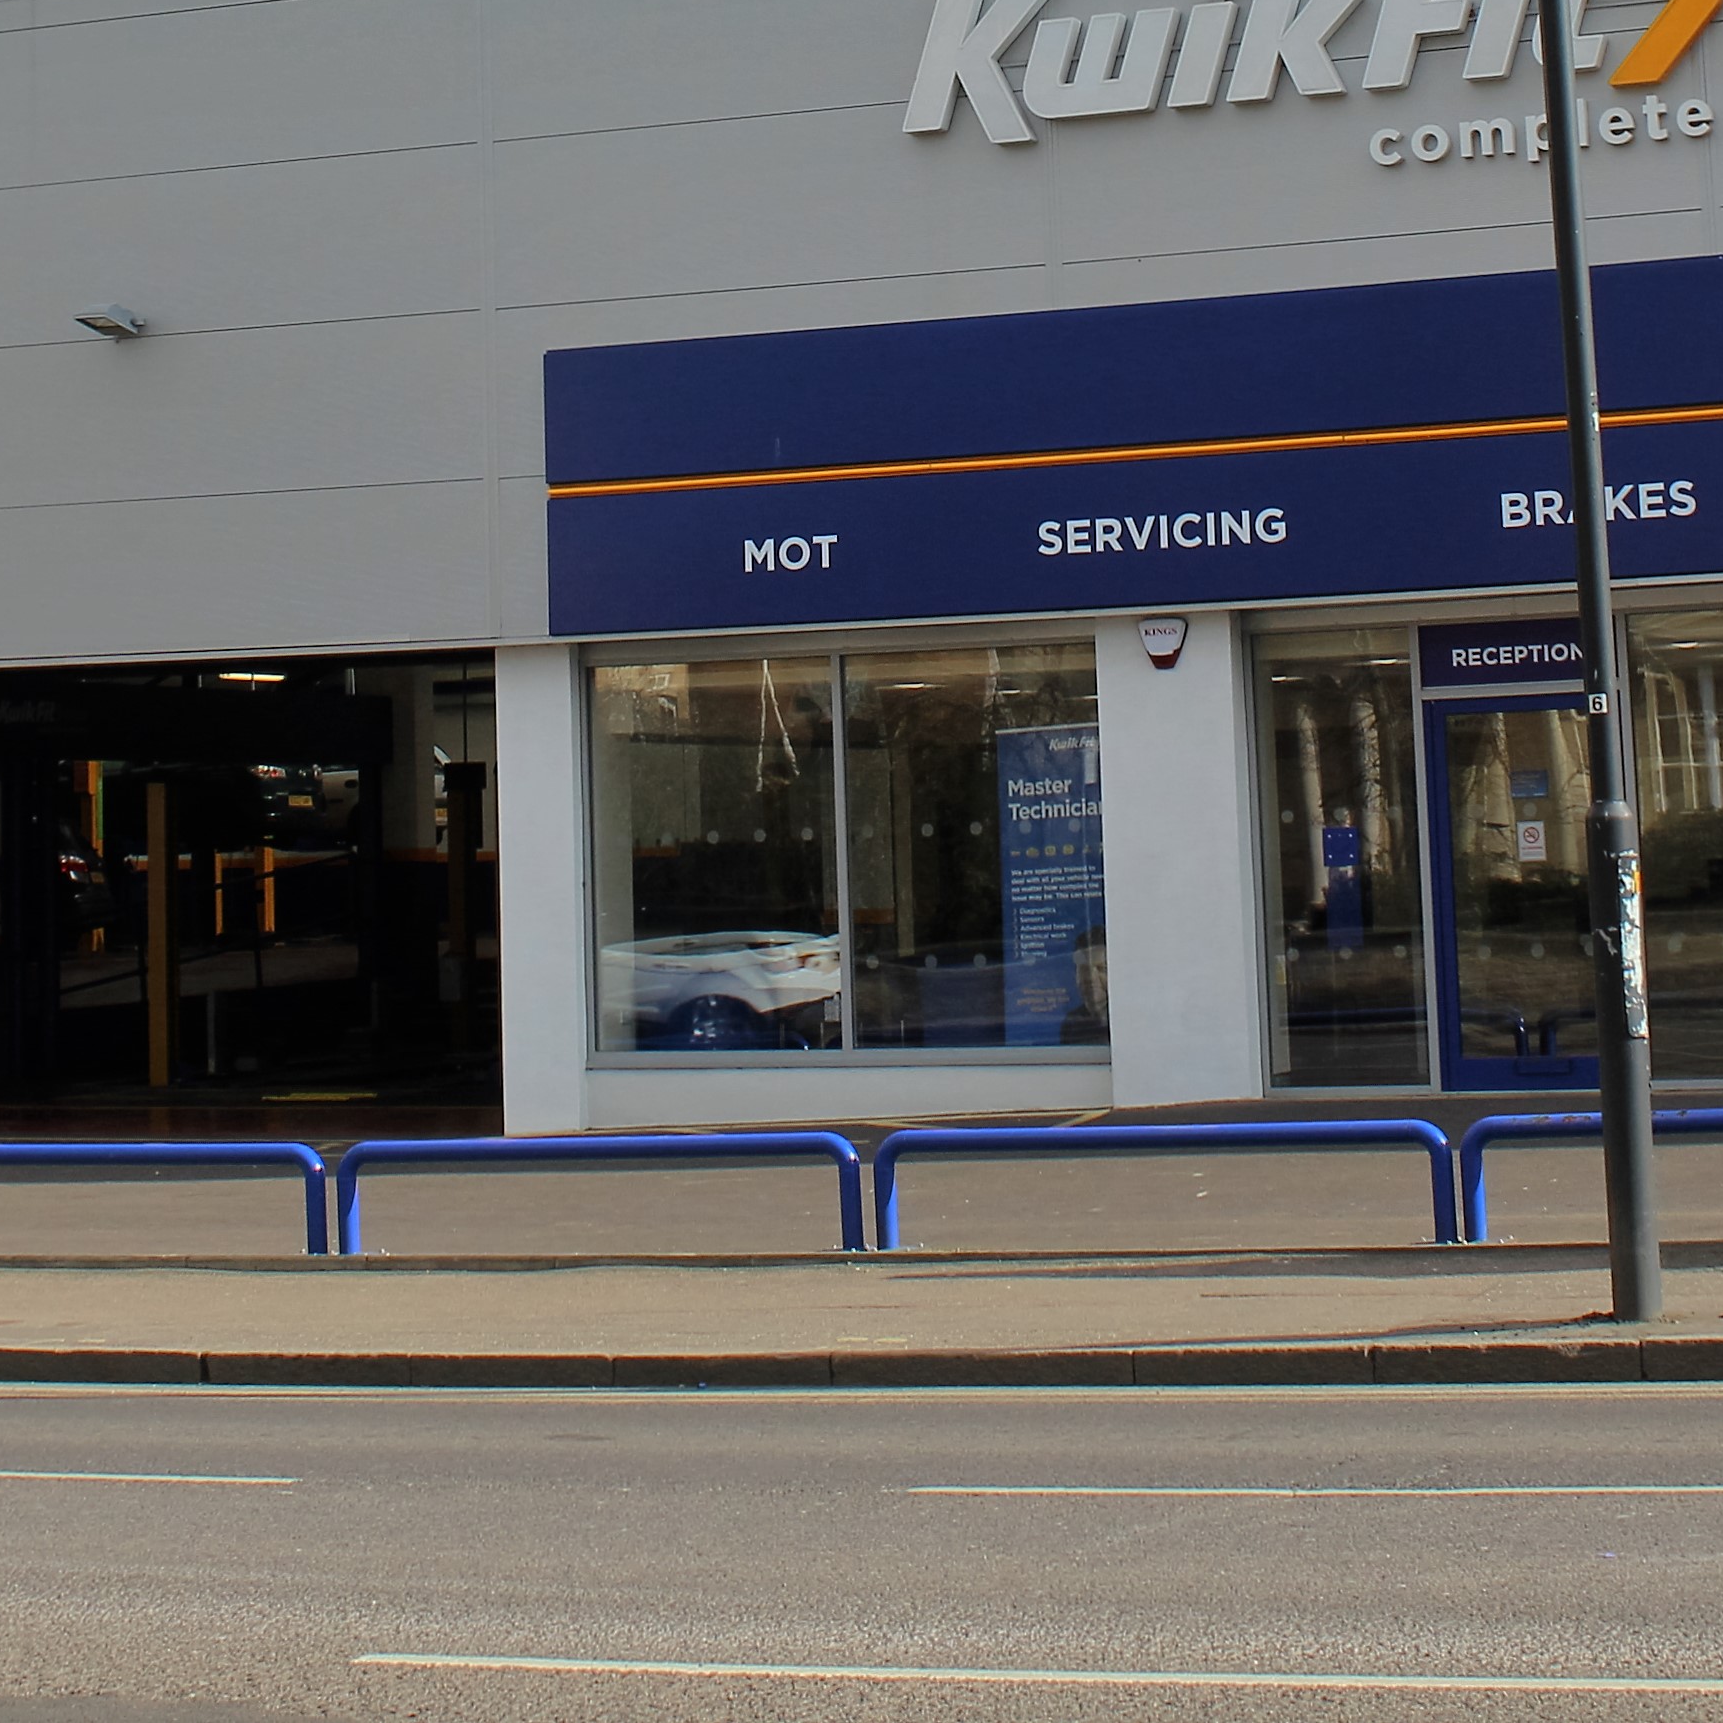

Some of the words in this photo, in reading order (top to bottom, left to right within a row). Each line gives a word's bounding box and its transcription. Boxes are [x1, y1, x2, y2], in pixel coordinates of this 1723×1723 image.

[1369, 94, 1714, 166] complete
[743, 534, 838, 573] MOT
[1037, 507, 1287, 556] SERVICING
[1500, 480, 1697, 528] BRKES
[1144, 628, 1178, 636] KINGS
[1592, 696, 1604, 712] 6
[1008, 778, 1072, 797] Master
